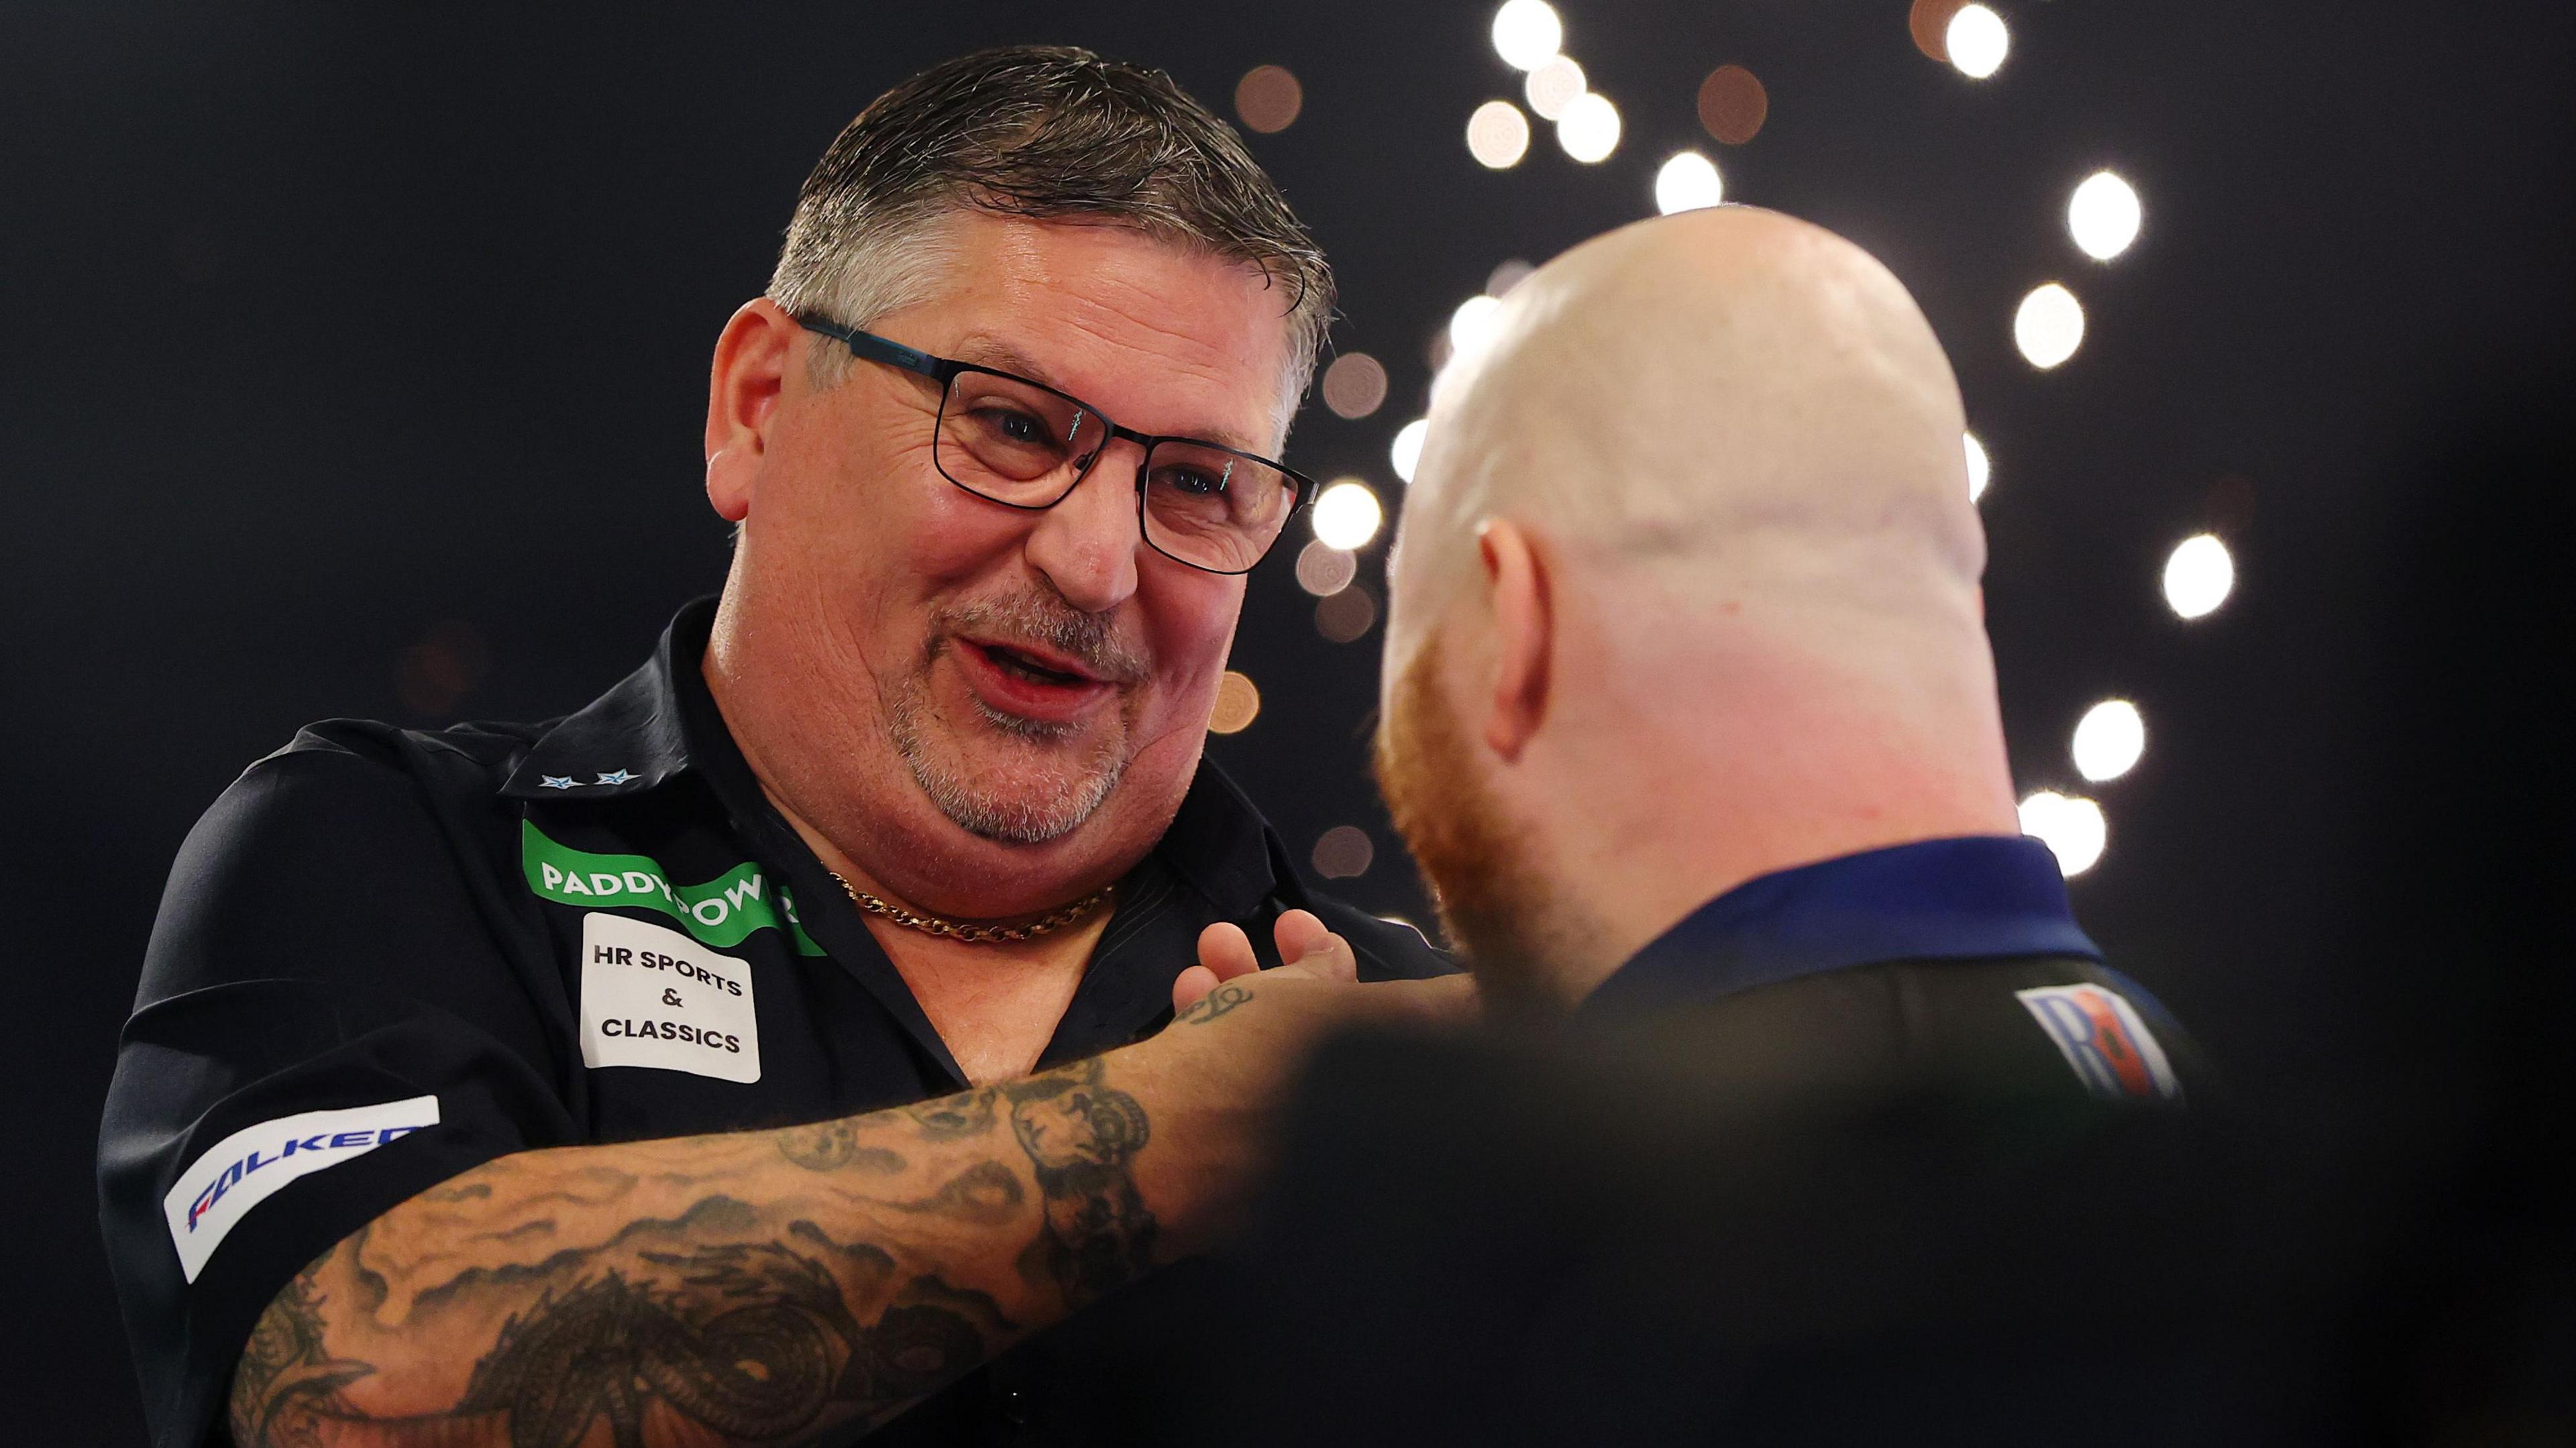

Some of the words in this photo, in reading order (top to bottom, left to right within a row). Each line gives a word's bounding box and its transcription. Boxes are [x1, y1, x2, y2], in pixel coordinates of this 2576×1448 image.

[541, 862, 672, 903] PADDY
[673, 873, 800, 926] POWR
[594, 944, 632, 966] HR
[641, 951, 742, 997] SPORTS
[661, 988, 684, 1008] &
[601, 1019, 740, 1054] CLASSICS
